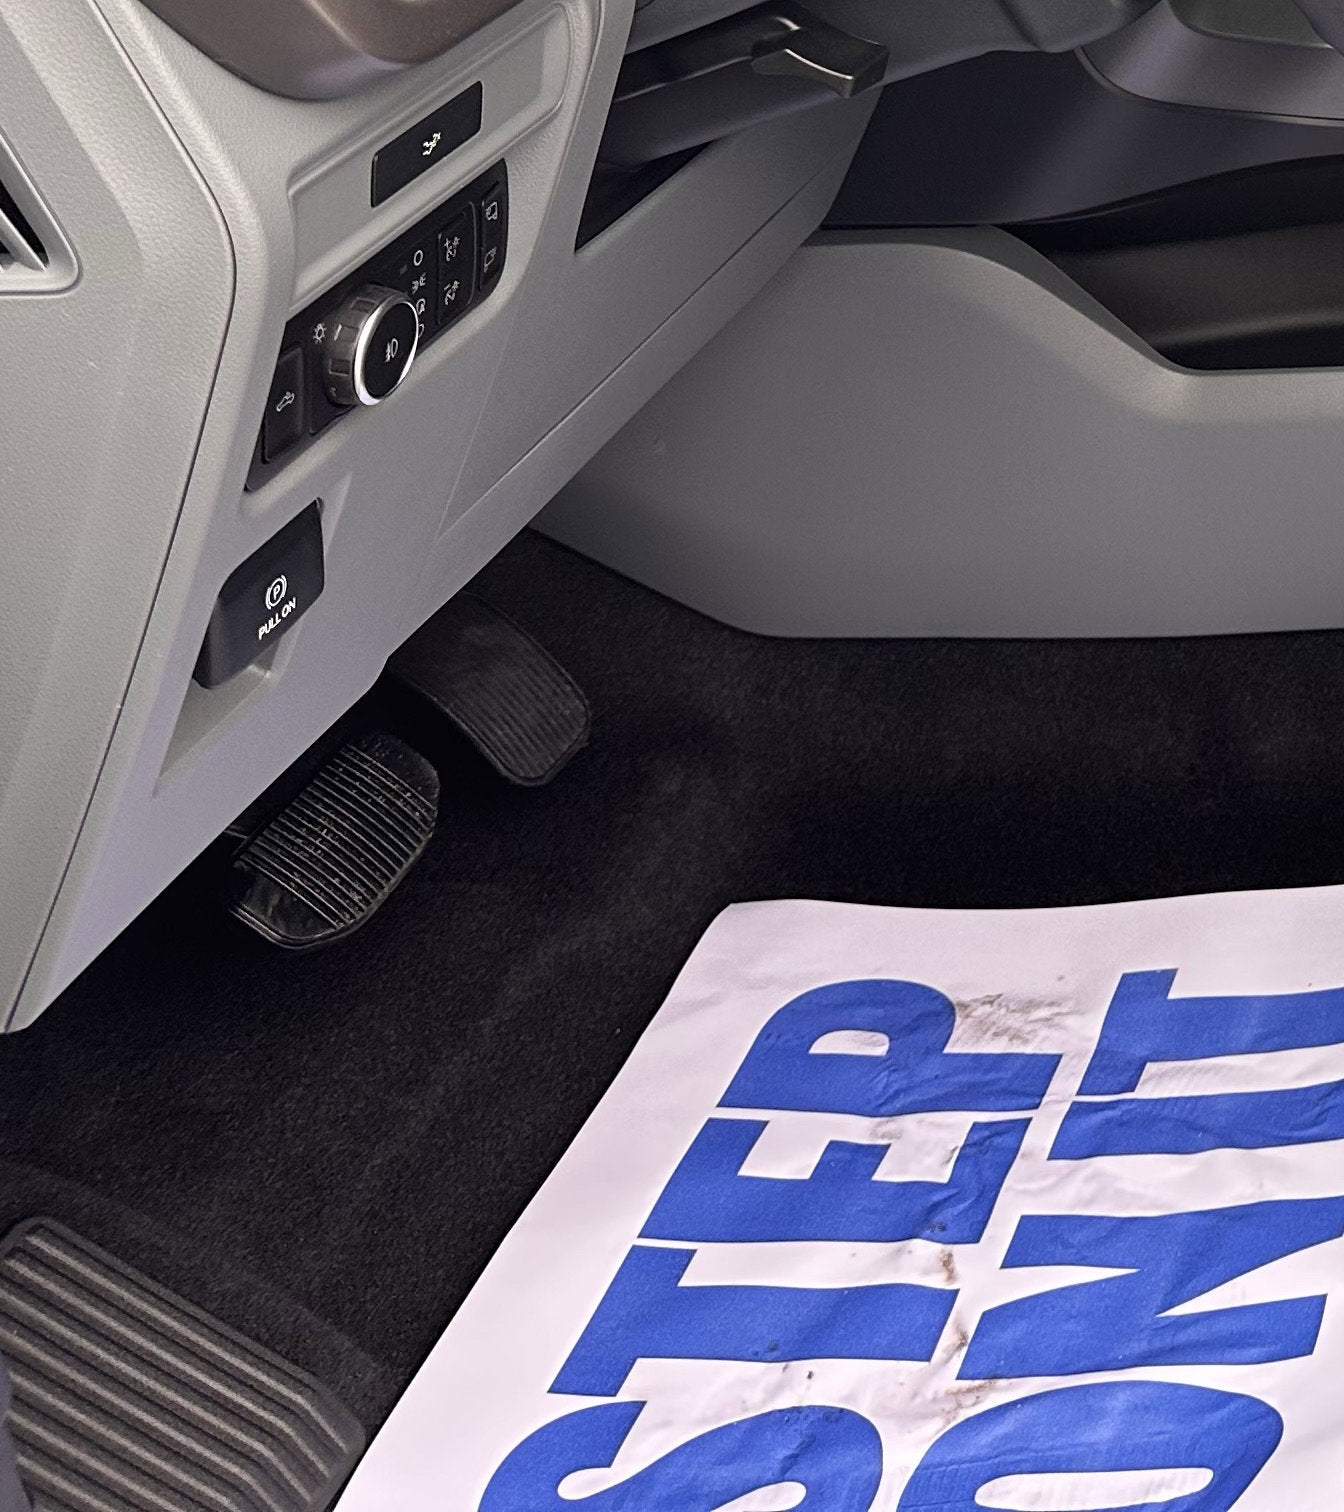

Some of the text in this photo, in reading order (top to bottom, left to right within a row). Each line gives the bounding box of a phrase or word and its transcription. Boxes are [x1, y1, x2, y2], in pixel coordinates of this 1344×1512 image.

[258, 597, 296, 640] PULL ON
[476, 978, 1064, 1512] STEP
